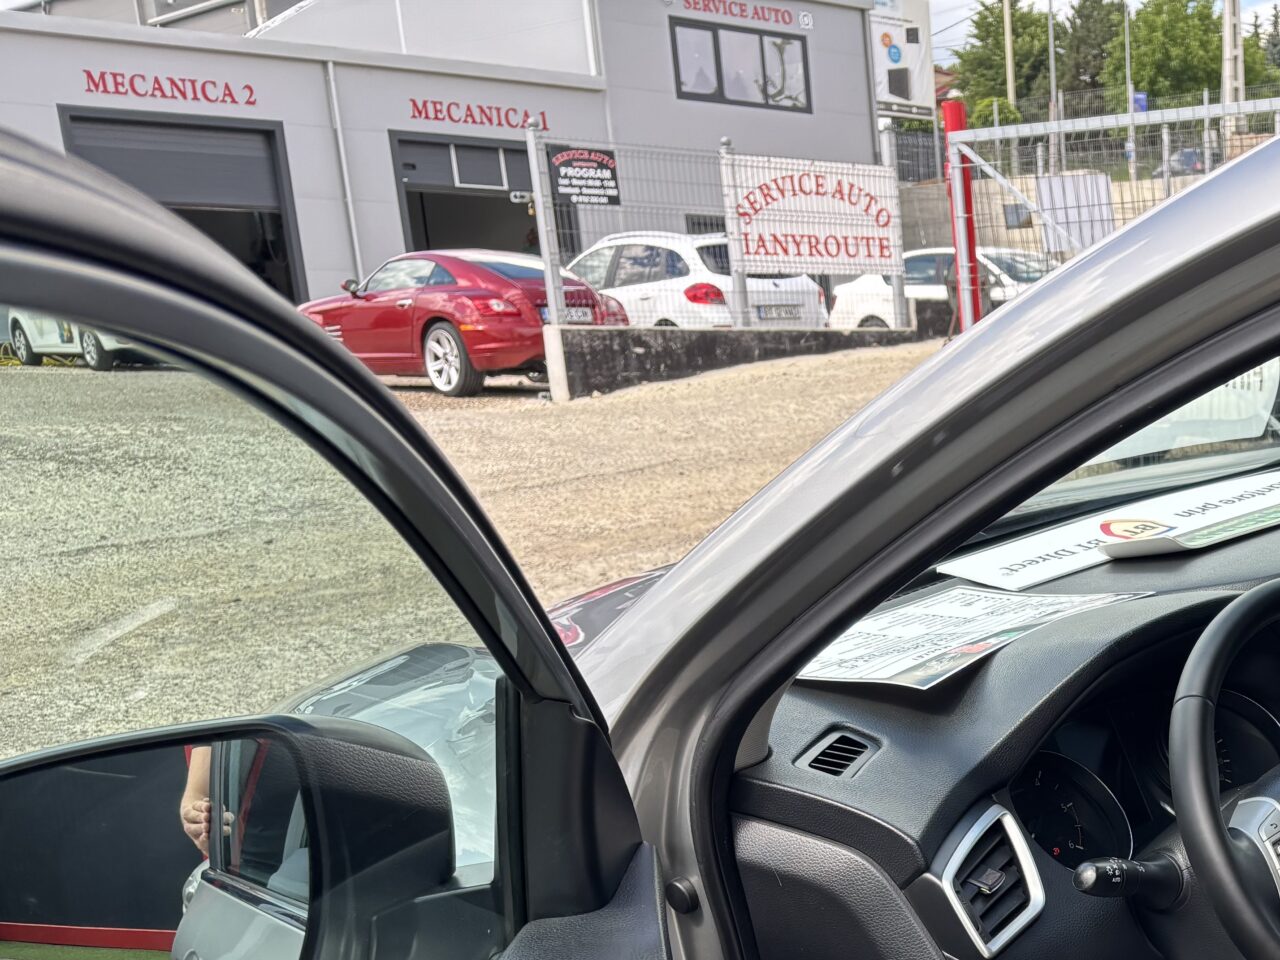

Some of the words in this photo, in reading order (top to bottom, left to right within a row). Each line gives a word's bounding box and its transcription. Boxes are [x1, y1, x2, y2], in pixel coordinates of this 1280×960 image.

[683, 0, 748, 18] SERVICE
[751, 5, 793, 25] AUTO
[82, 69, 239, 104] MECANICA
[242, 84, 257, 106] 2
[409, 98, 532, 129] MECANICA
[539, 110, 550, 131] 1
[735, 172, 827, 226] SERVICE
[831, 179, 892, 228] AUTO
[741, 231, 893, 259] IANYROUTE
[1173, 502, 1222, 518] prin
[1122, 522, 1156, 538] BT
[1068, 840, 1075, 849] 6
